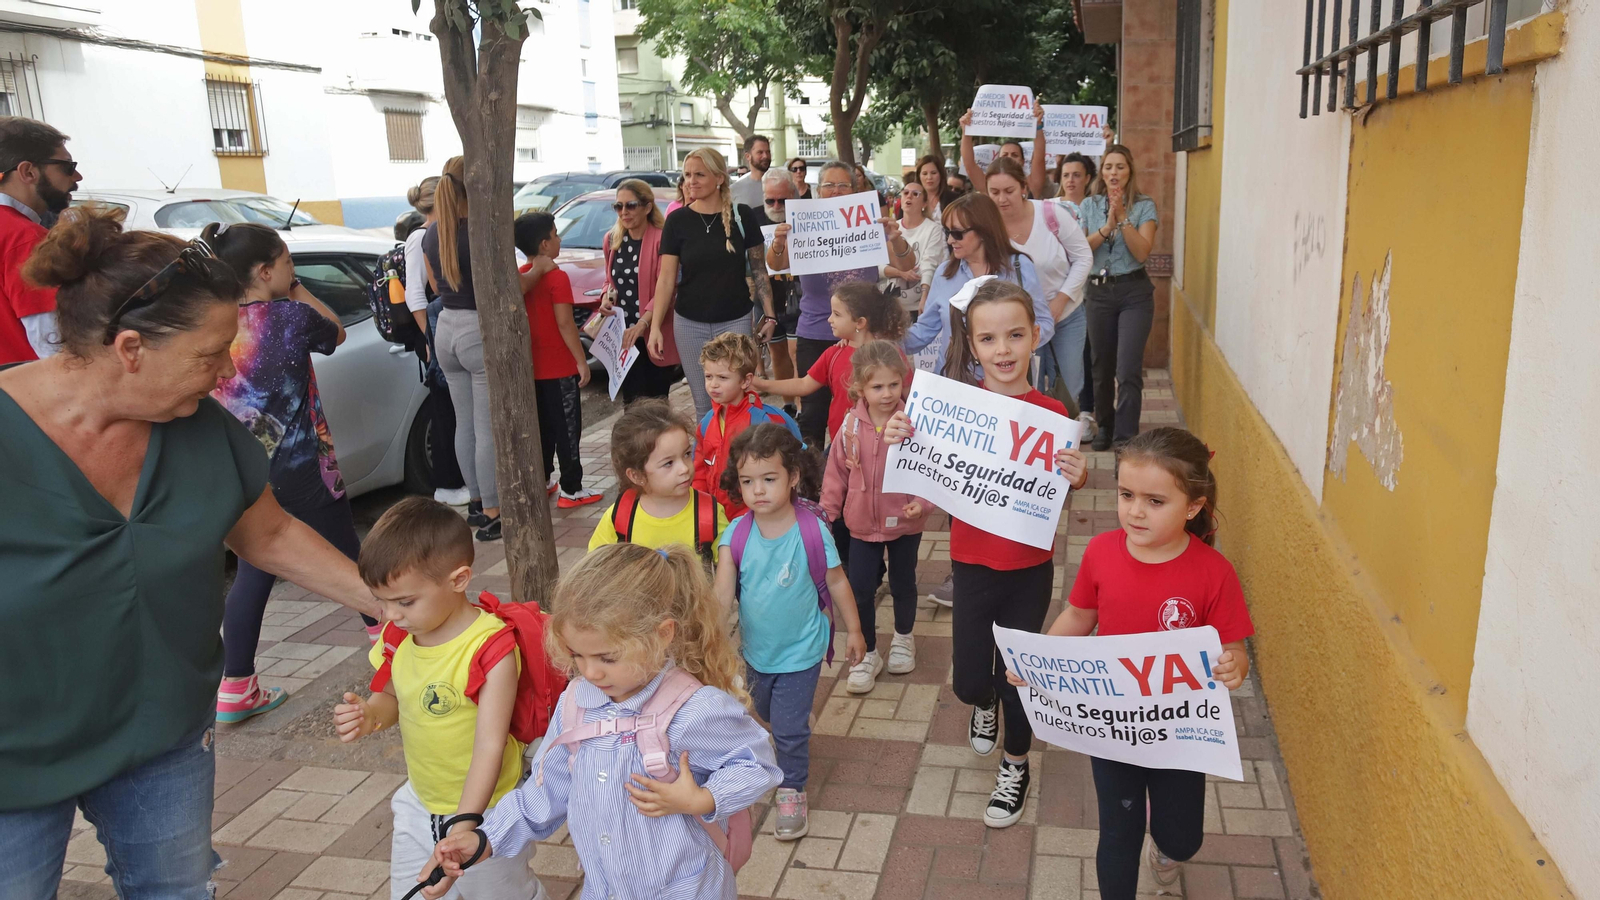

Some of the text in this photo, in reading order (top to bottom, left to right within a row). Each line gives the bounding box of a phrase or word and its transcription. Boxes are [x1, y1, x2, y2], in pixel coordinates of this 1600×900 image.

[989, 111, 1024, 120] Seguridad
[1079, 113, 1104, 129] YA!
[1060, 130, 1094, 139] Seguridad
[797, 210, 835, 221] COMEDOR
[839, 202, 877, 228] YA!
[797, 220, 840, 233] INFANTIL
[792, 238, 806, 248] Por
[807, 237, 815, 247] la
[817, 230, 867, 248] Seguridad
[868, 229, 879, 240] de
[793, 249, 830, 260] nuestros
[831, 246, 857, 258] hij@s
[602, 331, 613, 344] Por
[920, 359, 933, 369] Por
[921, 396, 999, 431] COMEDOR
[915, 413, 997, 455] INFANTIL
[899, 436, 1057, 500] Por la Seguridad de
[896, 458, 1010, 508] nuestros hij@s
[1014, 499, 1051, 514] AMPA ICA CEIP
[1020, 652, 1109, 675] COMEDOR
[1117, 650, 1216, 697] YA!
[1025, 669, 1125, 696] INFANTIL
[1029, 686, 1221, 726] Por la Seguridad de
[1034, 710, 1168, 746] nuestros hij@s
[1196, 727, 1209, 736] ICA
[1210, 728, 1224, 738] CEIP
